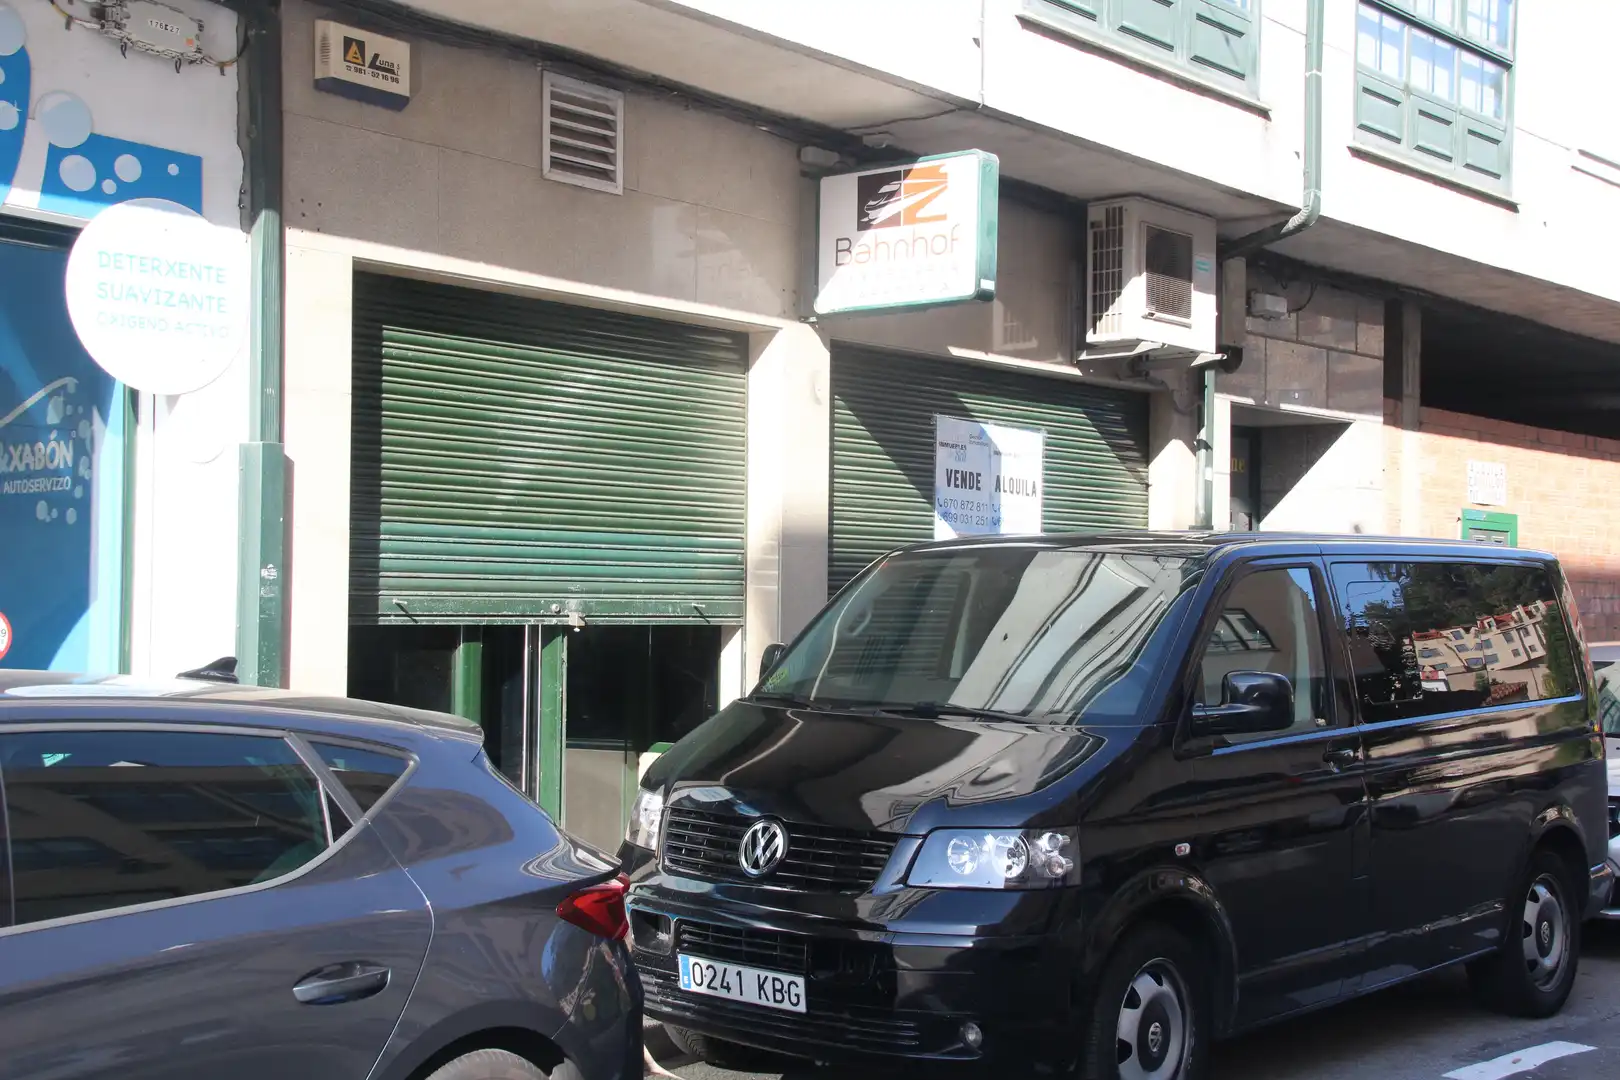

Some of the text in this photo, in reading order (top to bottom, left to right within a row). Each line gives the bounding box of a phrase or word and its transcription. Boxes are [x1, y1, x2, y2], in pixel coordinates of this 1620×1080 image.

[835, 222, 960, 267] Bahnhof
[96, 249, 228, 285] DETERXENTE
[95, 280, 229, 315] SUAVIZANTE
[3, 475, 71, 494] AUTOSERVIZO
[945, 468, 982, 491] VENDE
[994, 474, 1037, 498] ALQUILA
[943, 498, 959, 509] 670
[960, 500, 974, 512] 872
[691, 961, 801, 1008] 0241 KBG
